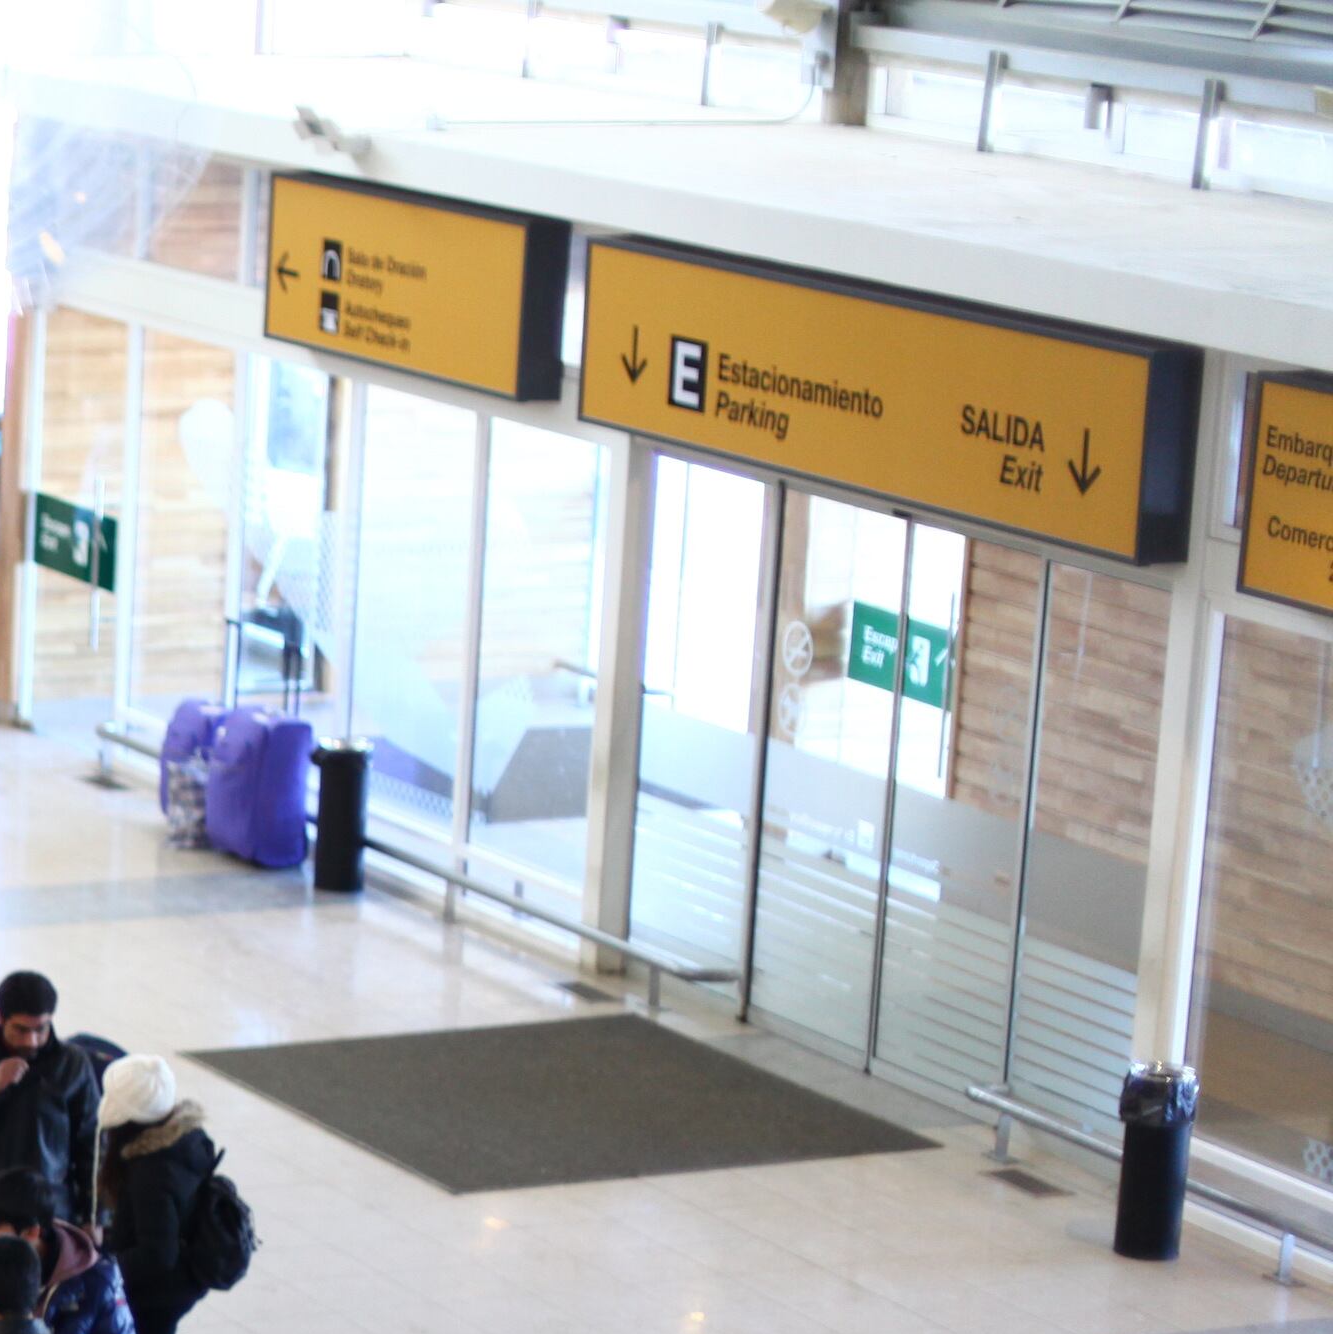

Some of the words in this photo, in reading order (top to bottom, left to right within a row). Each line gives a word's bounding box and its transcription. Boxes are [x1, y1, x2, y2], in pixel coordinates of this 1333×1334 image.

[718, 352, 884, 420] Estacionamiento
[715, 391, 790, 441] Parking
[961, 403, 1045, 453] SALIDA
[999, 454, 1044, 493] Exit
[863, 624, 899, 656] Escap
